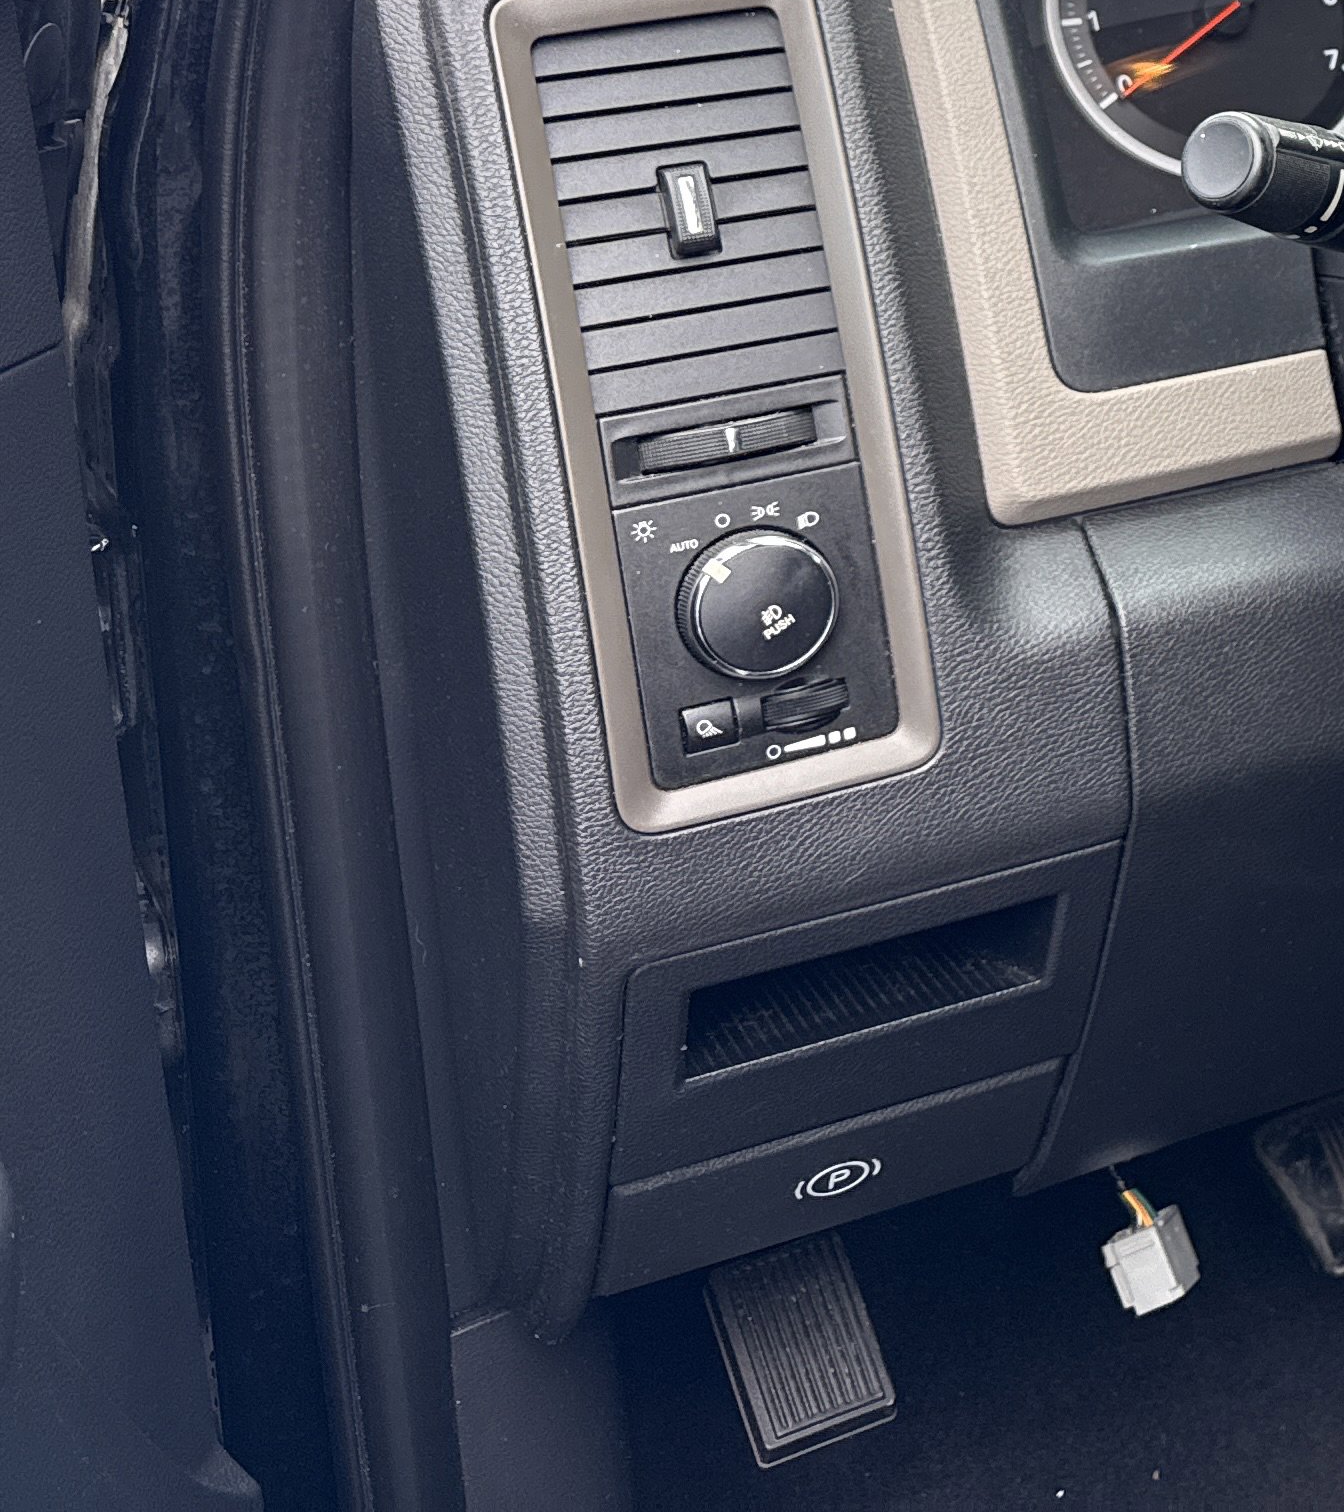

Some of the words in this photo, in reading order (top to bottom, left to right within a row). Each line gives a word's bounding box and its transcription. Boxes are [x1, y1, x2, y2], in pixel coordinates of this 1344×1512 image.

[1087, 10, 1101, 31] 1
[1323, 49, 1339, 70] 7
[669, 538, 699, 554] AUTO
[763, 614, 796, 640] PUSH
